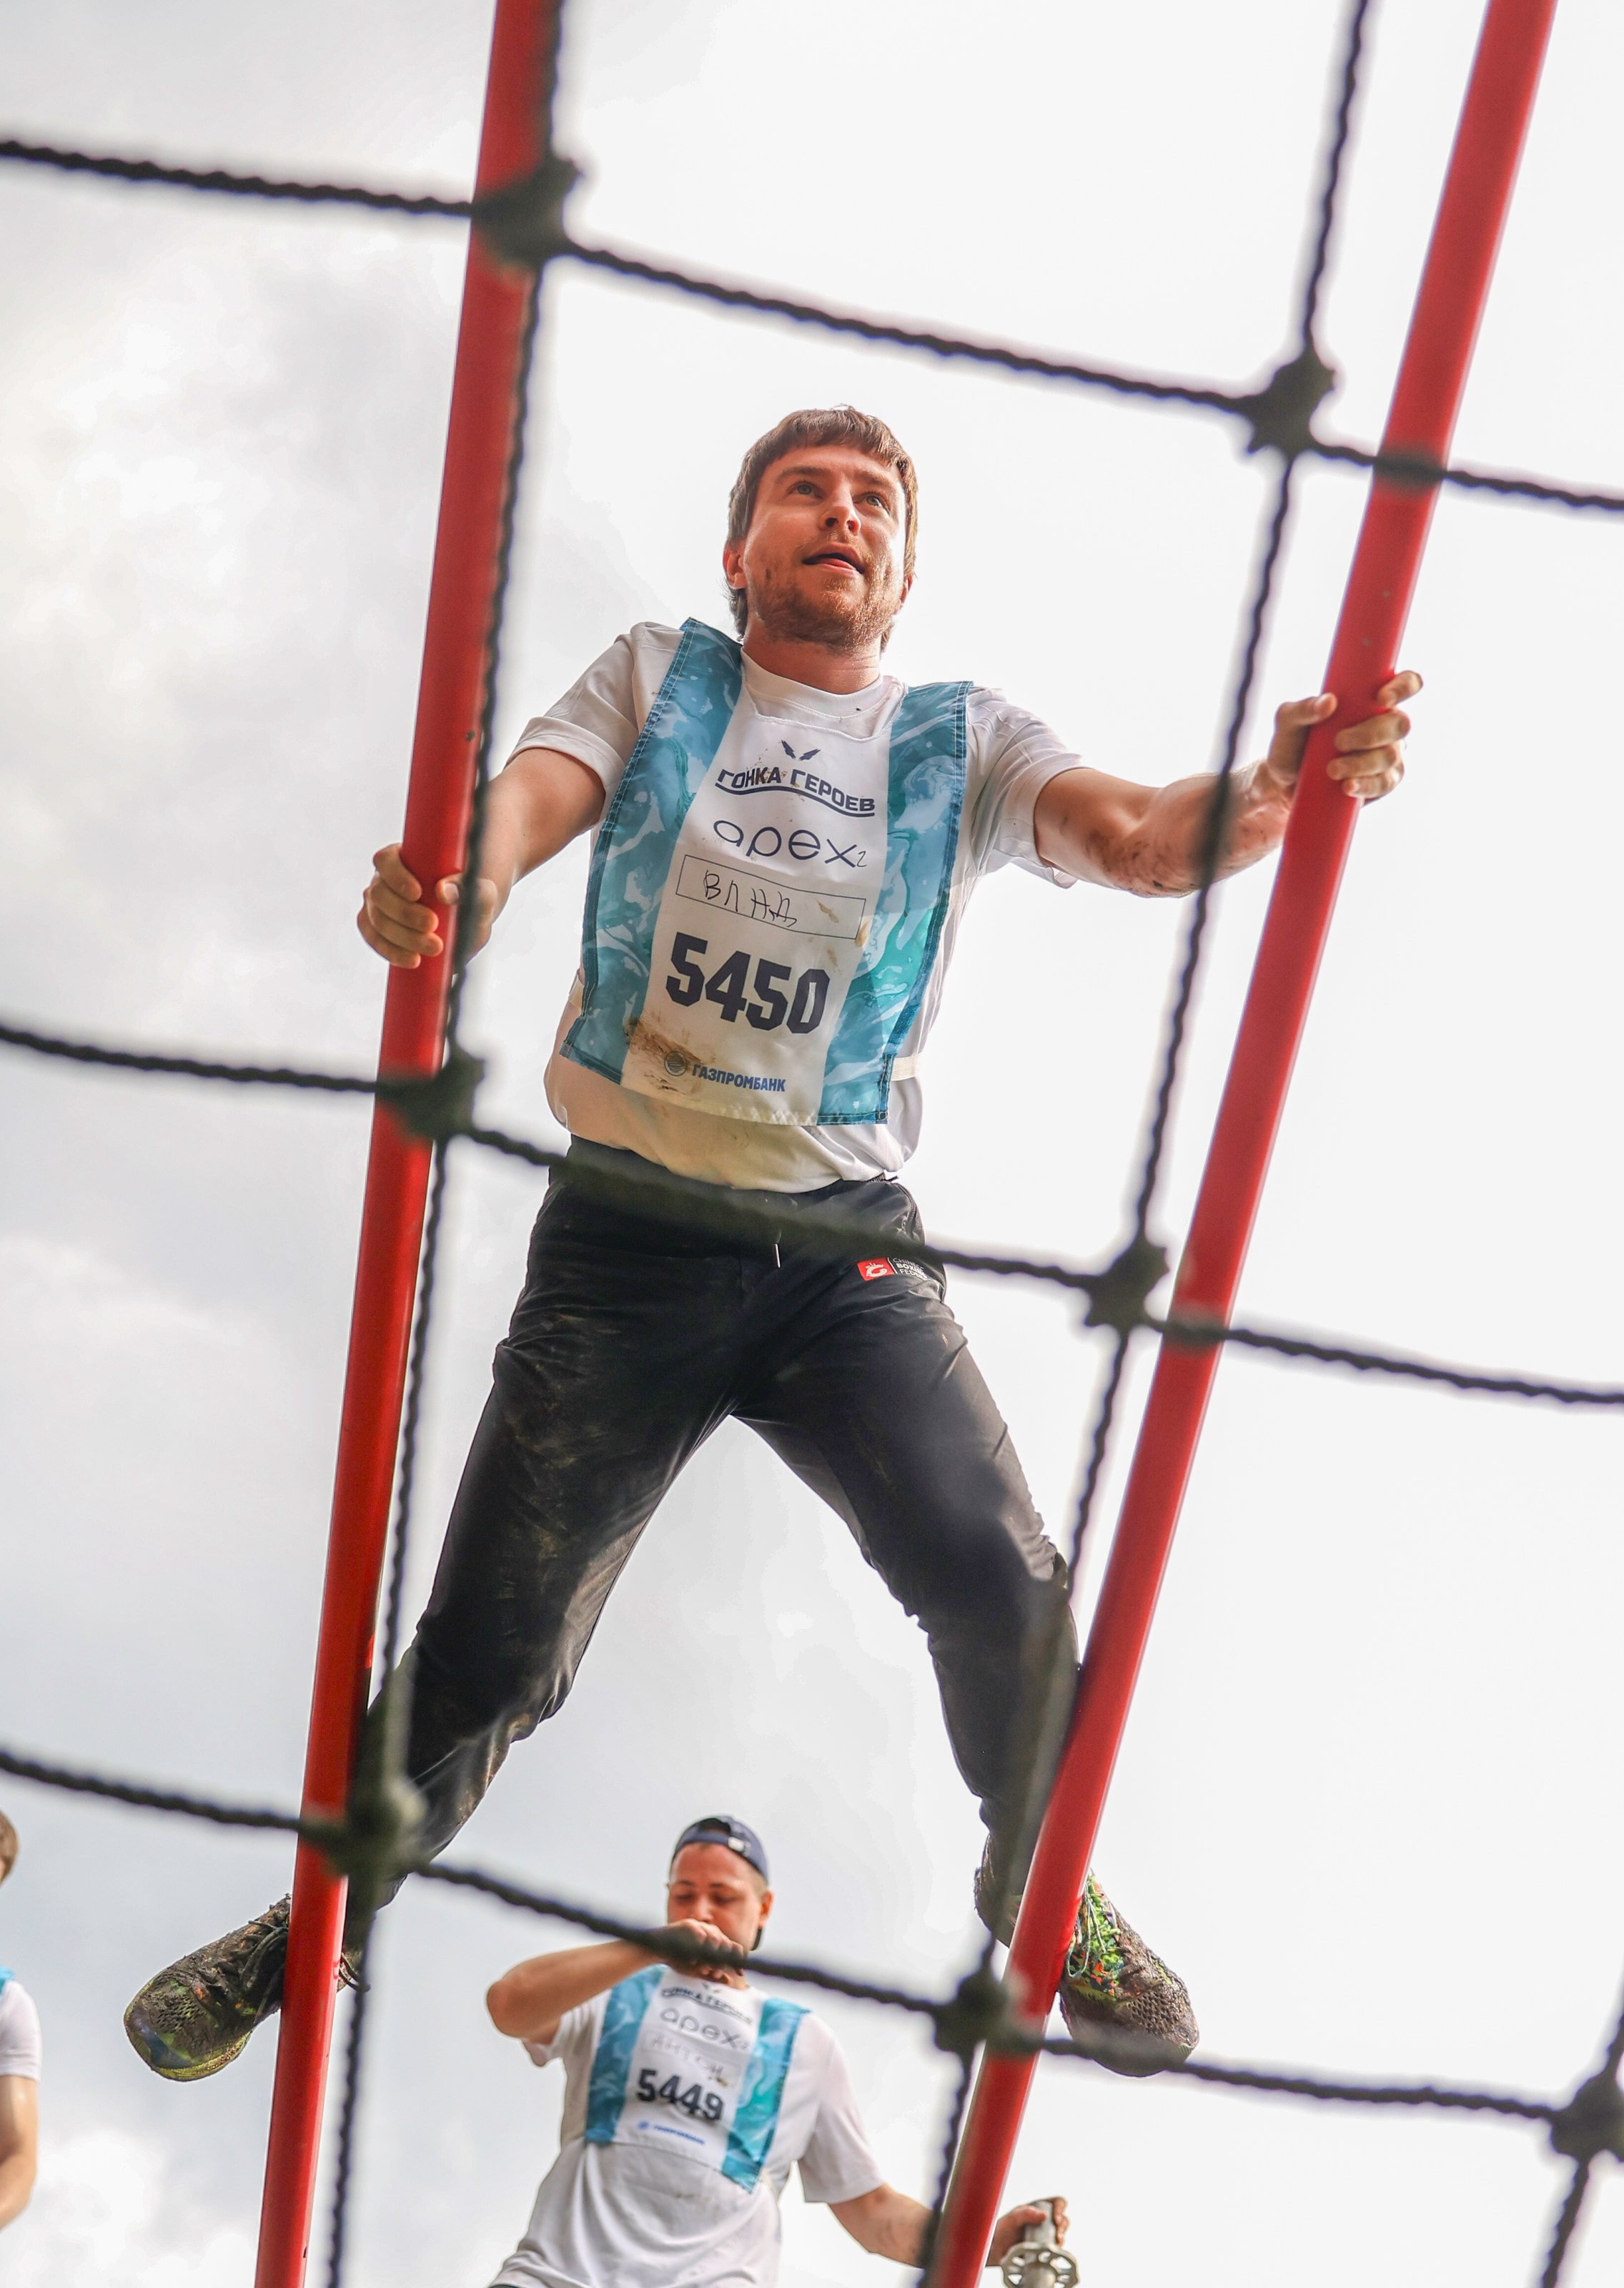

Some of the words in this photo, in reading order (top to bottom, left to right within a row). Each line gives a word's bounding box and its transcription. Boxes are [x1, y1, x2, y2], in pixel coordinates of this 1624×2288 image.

[717, 766, 781, 789] ГОНКА
[790, 768, 875, 812] ГЕРОЕВ
[713, 820, 858, 868] apex
[665, 932, 830, 1034] 5450
[692, 1064, 786, 1092] ГАЗПРОМБАНК
[635, 2068, 724, 2121] 5449
